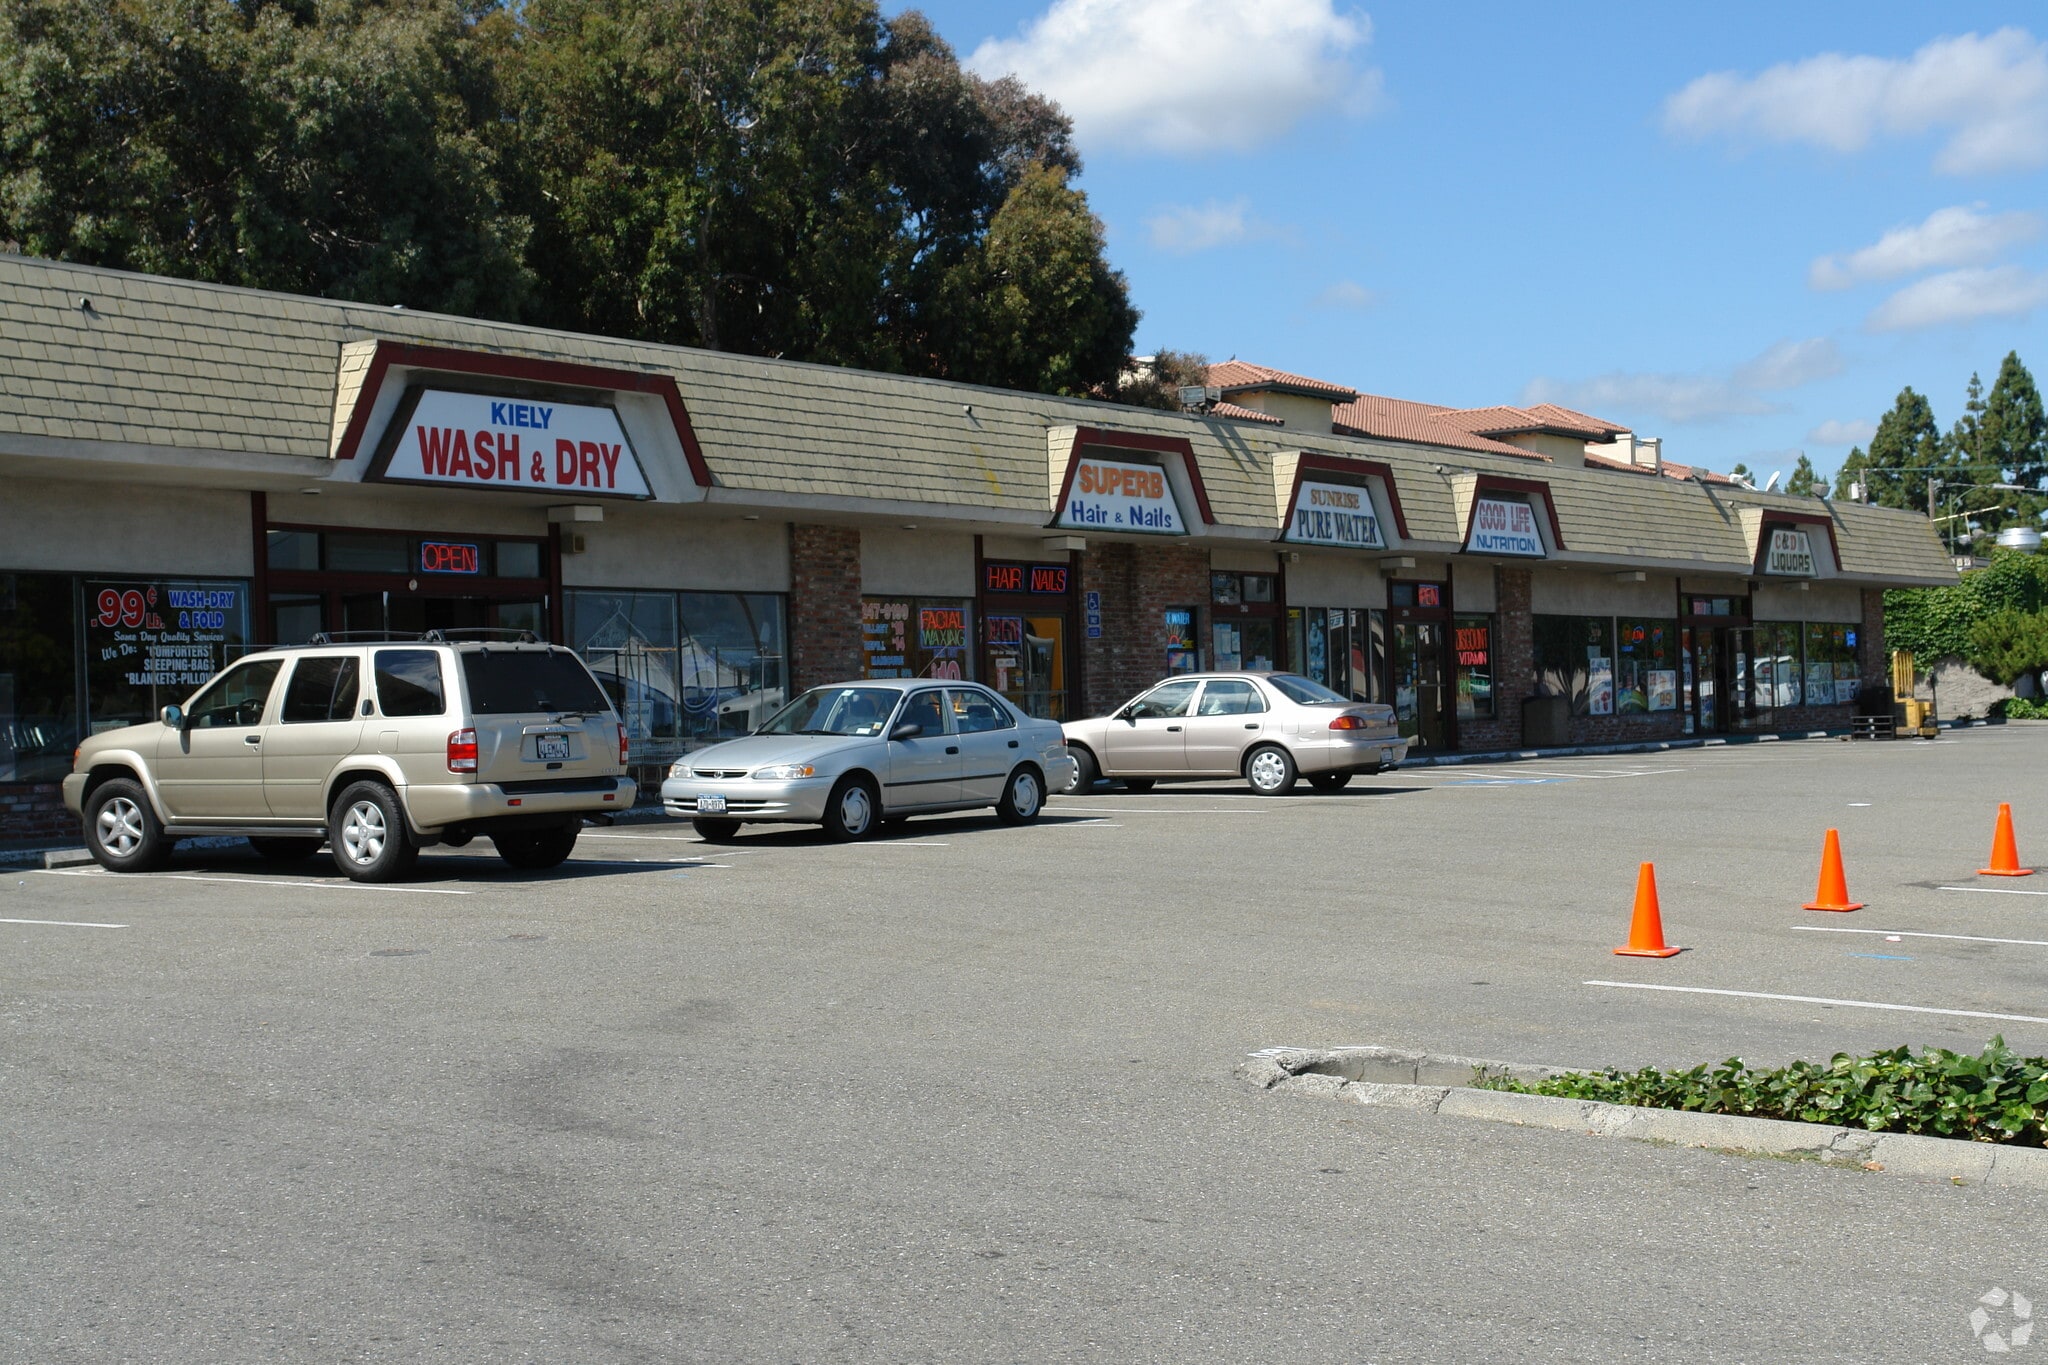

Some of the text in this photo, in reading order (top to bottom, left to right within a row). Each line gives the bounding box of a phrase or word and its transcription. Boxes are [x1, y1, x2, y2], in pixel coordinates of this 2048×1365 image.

[491, 401, 553, 429] KIELY
[417, 425, 622, 488] WASH & DRY
[1078, 464, 1164, 499] SUPERB
[1311, 488, 1361, 509] SUNRISE
[1071, 501, 1172, 528] Hair & Nails
[1480, 502, 1530, 533] GOOD LIFE
[1297, 509, 1377, 543] PURE WATER
[1476, 534, 1536, 551] NUTRITION
[424, 544, 476, 571] OPEN
[1772, 552, 1810, 573] LIQUORS
[988, 567, 1066, 591] HAIR NAILS
[168, 590, 235, 608] WASH-DRY
[179, 611, 224, 629] & FOLD
[921, 611, 966, 629] FACIAL
[114, 631, 224, 643] Same Day Quality Services
[921, 629, 965, 646] WAXING
[101, 648, 118, 661] We
